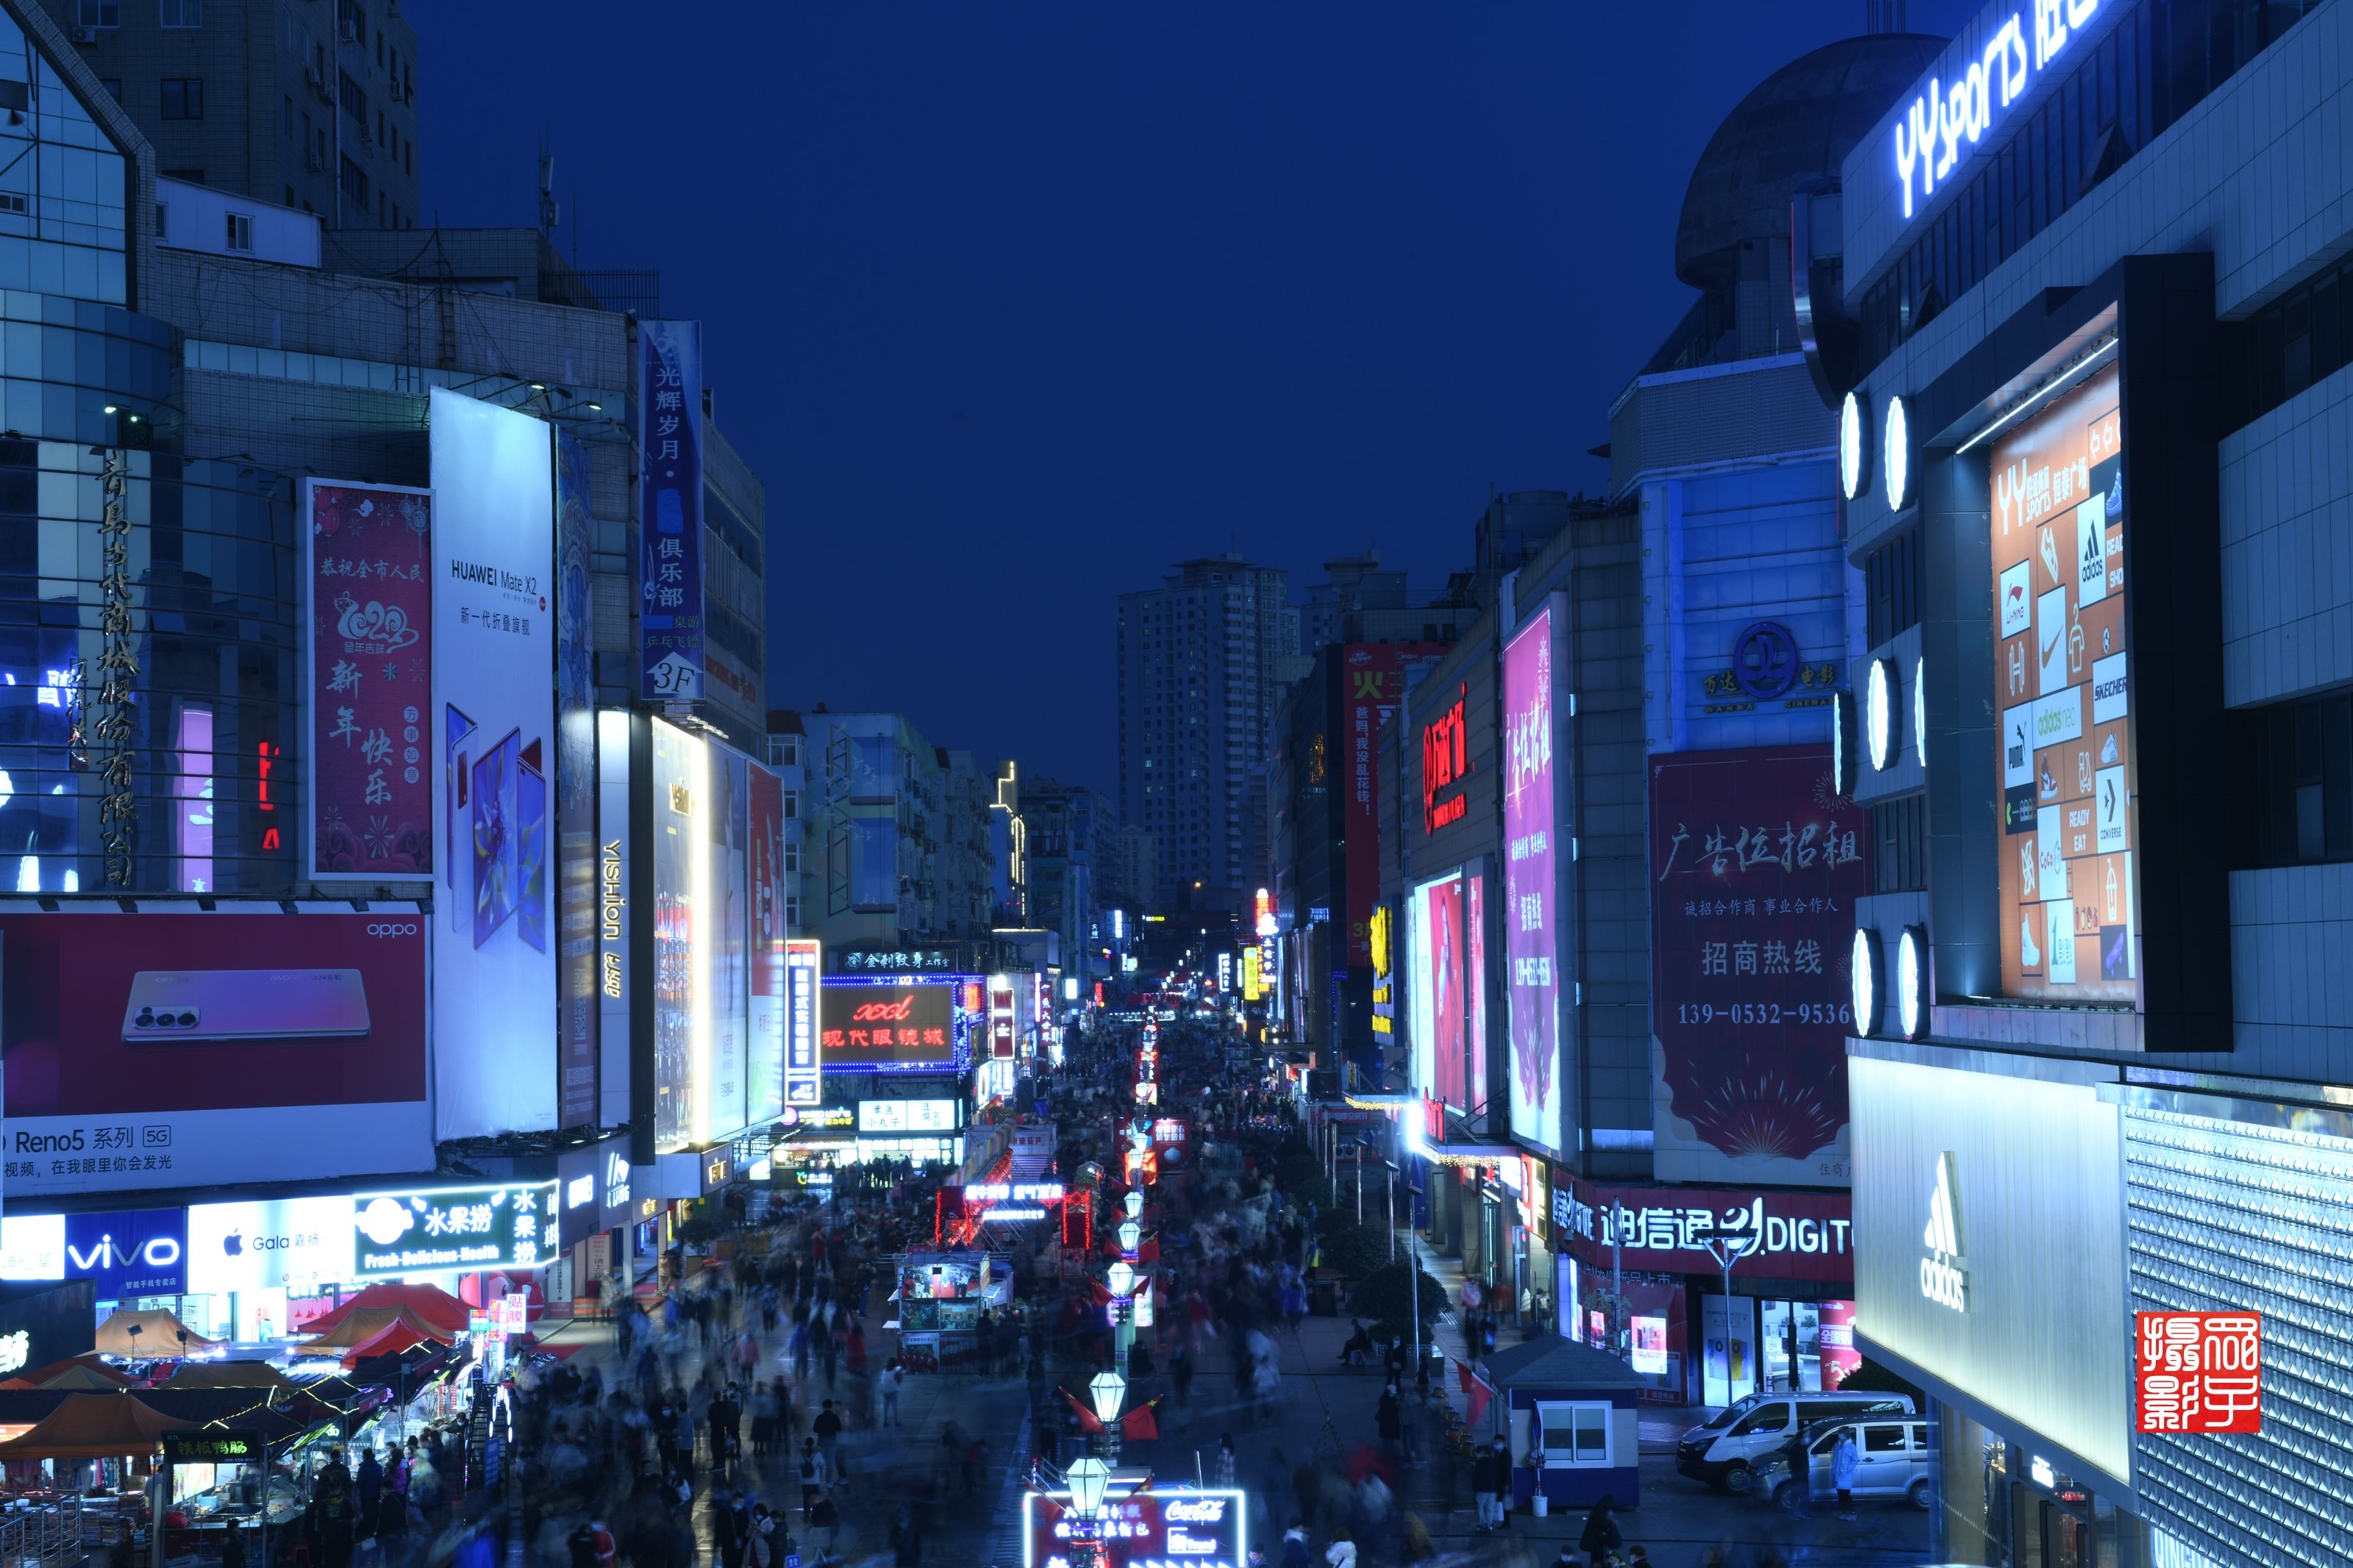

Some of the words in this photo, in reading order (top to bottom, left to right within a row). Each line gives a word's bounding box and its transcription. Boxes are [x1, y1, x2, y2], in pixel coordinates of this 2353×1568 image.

[2054, 457, 2087, 506] 恒泰广场
[320, 556, 424, 582] 恭祝全市人民
[452, 559, 497, 587] HUAWEI
[501, 570, 522, 592] Mate
[525, 576, 537, 595] X2
[658, 537, 683, 607] 俱乐部
[2082, 557, 2103, 584] adidas
[461, 606, 529, 635] 新一代折叠旗舰
[674, 615, 700, 629] 桌游
[345, 641, 387, 654] 鼠年吉祥
[646, 635, 700, 648] 乒乓飞镖
[654, 662, 695, 692] 3F
[1704, 670, 1738, 693] 万达
[1801, 665, 1835, 687] 电影
[2038, 707, 2062, 737] adidas
[2063, 706, 2075, 728] neo
[404, 706, 419, 784] 万事如意
[2070, 808, 2090, 828] READY
[2074, 834, 2087, 851] EAT
[2101, 827, 2121, 840] CONVERSE
[1660, 820, 1863, 881] 广告位招租
[1683, 899, 1757, 917] 诚招合作商
[1763, 897, 1839, 914] 事业合作人
[1701, 939, 1823, 975] 招商热线
[1679, 1003, 1850, 1025] 139-0532-9536
[822, 1029, 945, 1046] 现代眼镜城
[867, 1117, 901, 1128] 小丸子
[15, 1128, 85, 1153] Reno5
[93, 1127, 134, 1150] 系列
[147, 1129, 168, 1143] 5G
[425, 1204, 493, 1236] 水果捞
[513, 1189, 537, 1264] 水果捞
[253, 1236, 290, 1250] Gala
[1767, 1216, 1854, 1254] DIGIT
[68, 1234, 180, 1270] vivo
[126, 1278, 176, 1289] 智能手机专卖店
[1921, 1253, 1966, 1313] adidas
[508, 1296, 523, 1322] 贴膜
[177, 1441, 248, 1455] 铁板鸭肠
